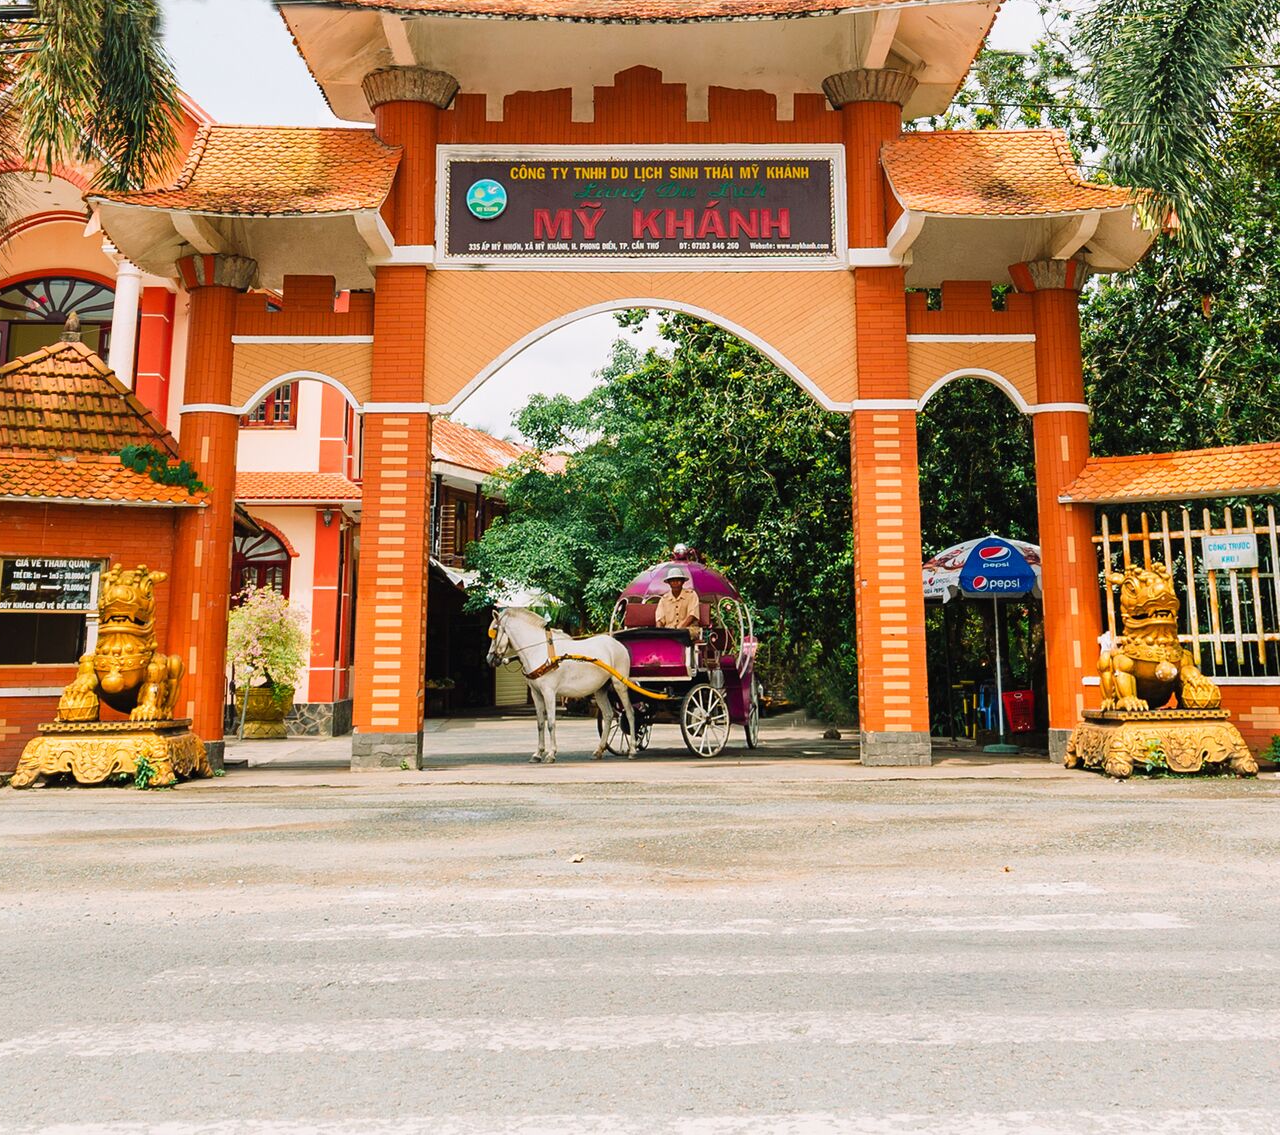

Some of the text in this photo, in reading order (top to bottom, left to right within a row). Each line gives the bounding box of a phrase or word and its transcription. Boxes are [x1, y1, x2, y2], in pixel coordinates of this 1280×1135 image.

[510, 164, 810, 182] CÔNG TY TNHH DU LỊCH SINH THÁI MỸ KHÁNH
[655, 182, 697, 198] Du
[533, 200, 791, 240] MỸ KHÁNH
[15, 558, 90, 569] GIÁ VÉ THAM QUAN
[990, 578, 1020, 590] pepsi
